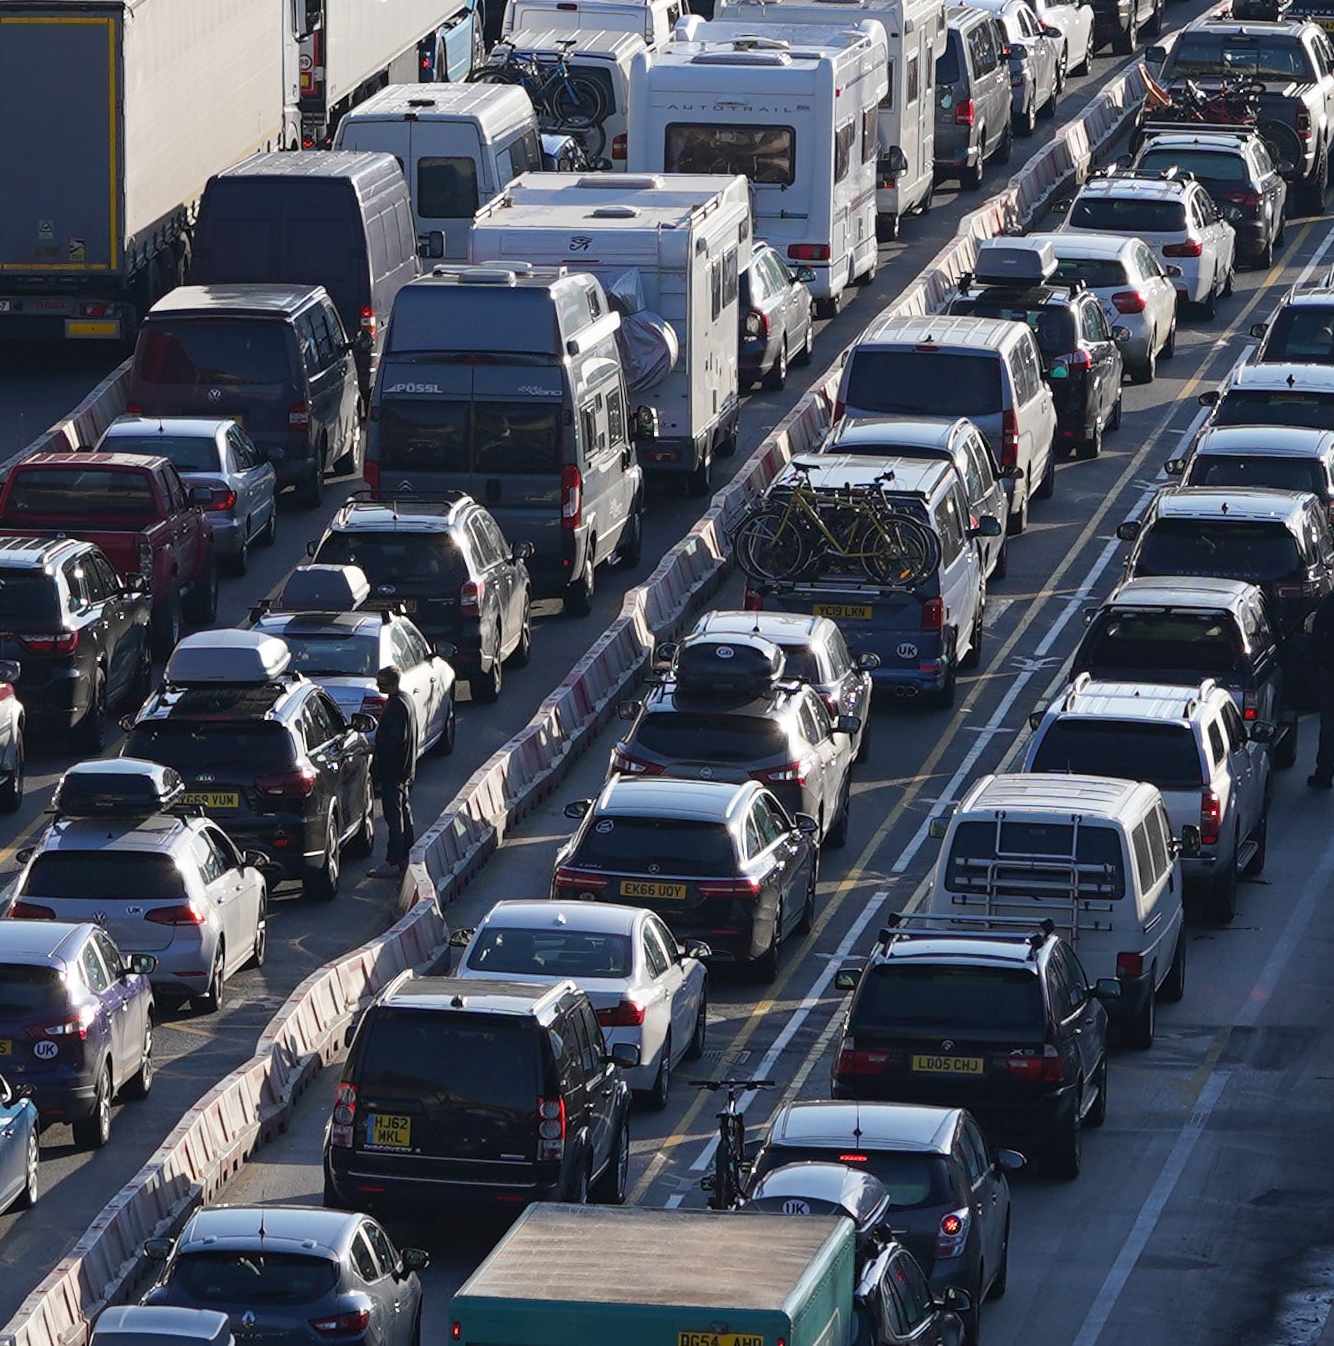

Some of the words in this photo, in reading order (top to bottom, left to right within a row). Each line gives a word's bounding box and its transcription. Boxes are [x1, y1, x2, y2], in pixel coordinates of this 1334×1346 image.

[395, 382, 443, 393] PÖSSL
[818, 605, 843, 617] YC19
[844, 605, 865, 618] LKN
[898, 645, 915, 656] UK
[211, 793, 234, 806] VUM
[624, 882, 657, 896] EK66
[37, 1044, 54, 1056] UK
[954, 1056, 978, 1072] CHJ
[373, 1114, 408, 1129] HJ62
[378, 1128, 402, 1143] MKL
[785, 1202, 805, 1215] UK
[677, 1333, 720, 1346] DG54
